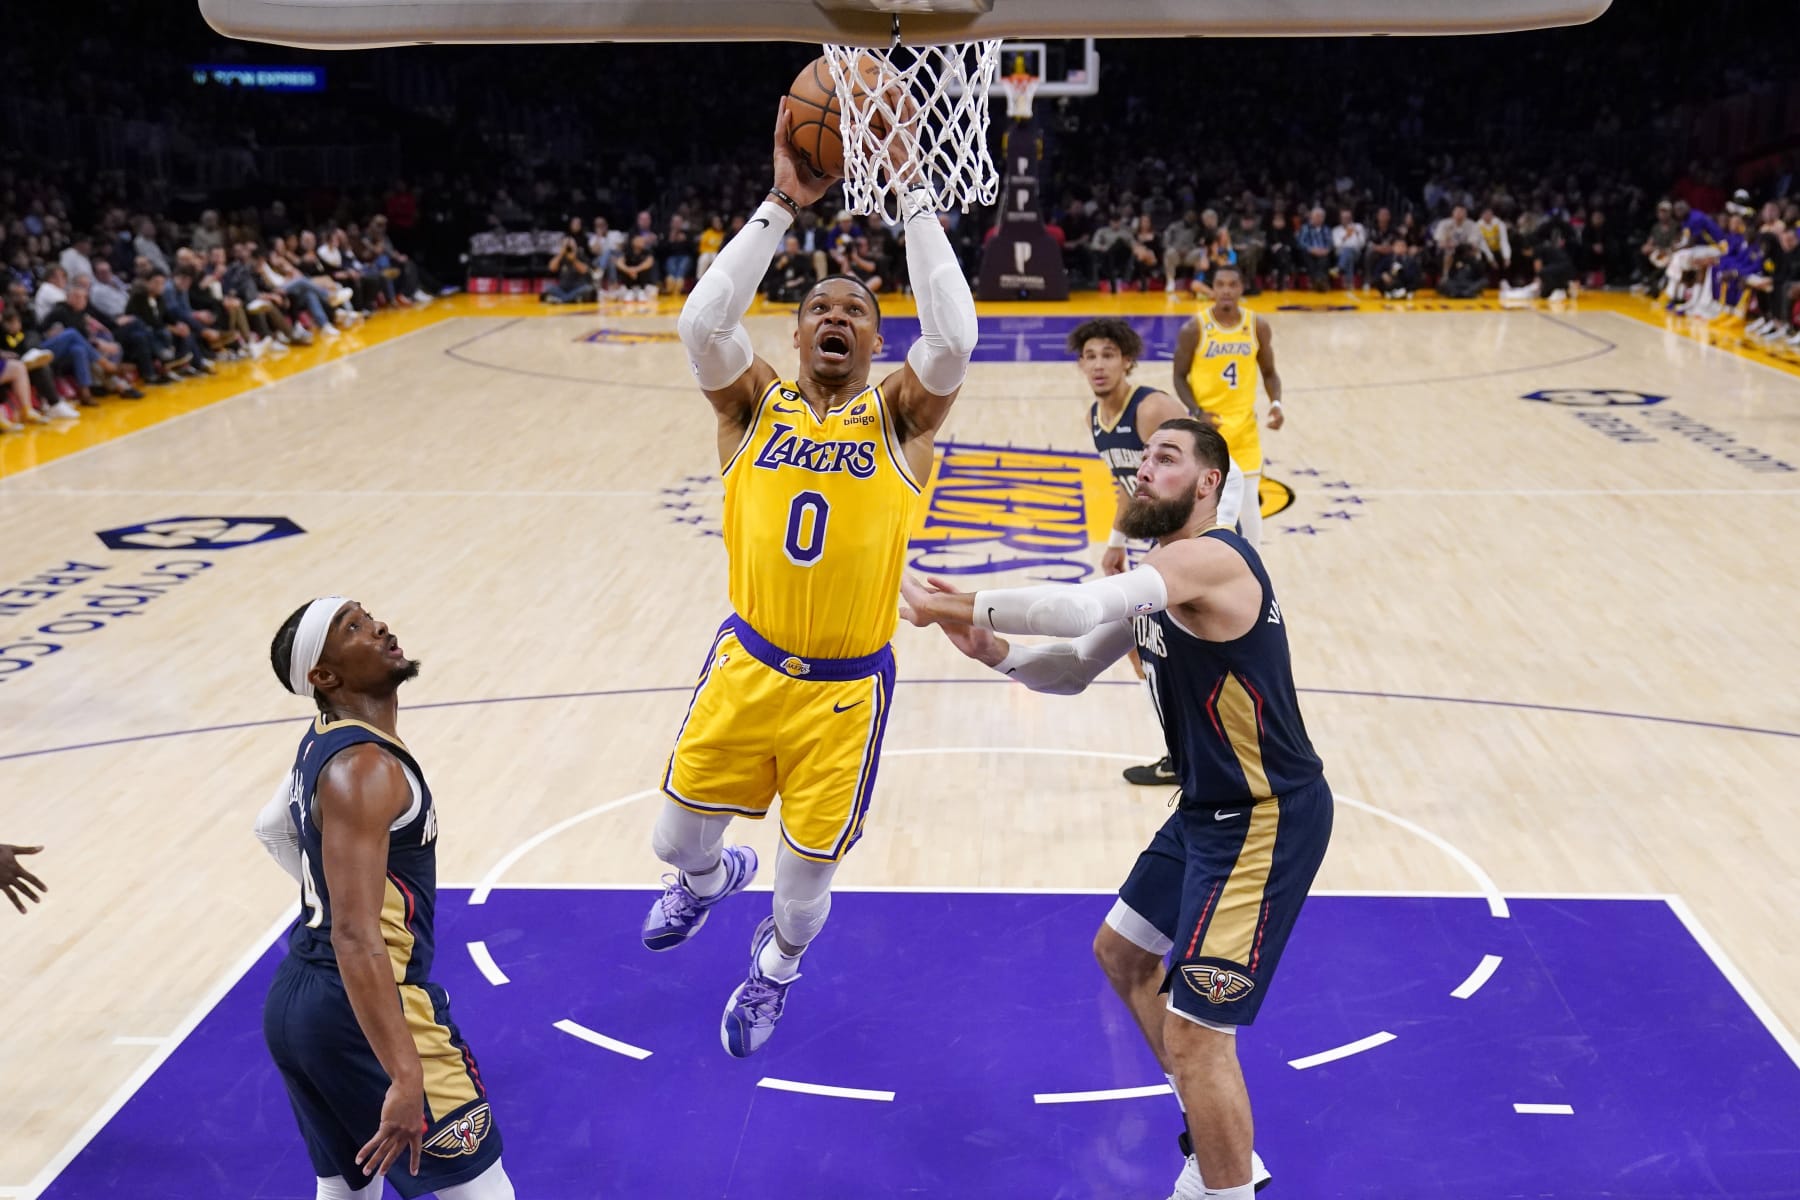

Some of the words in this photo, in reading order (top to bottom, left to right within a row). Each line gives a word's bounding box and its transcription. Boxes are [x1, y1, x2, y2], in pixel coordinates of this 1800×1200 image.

[1222, 361, 1238, 389] 4
[782, 390, 796, 400] 6
[844, 415, 875, 426] bibigo
[753, 423, 876, 479] LAKERS
[783, 489, 830, 567] 0
